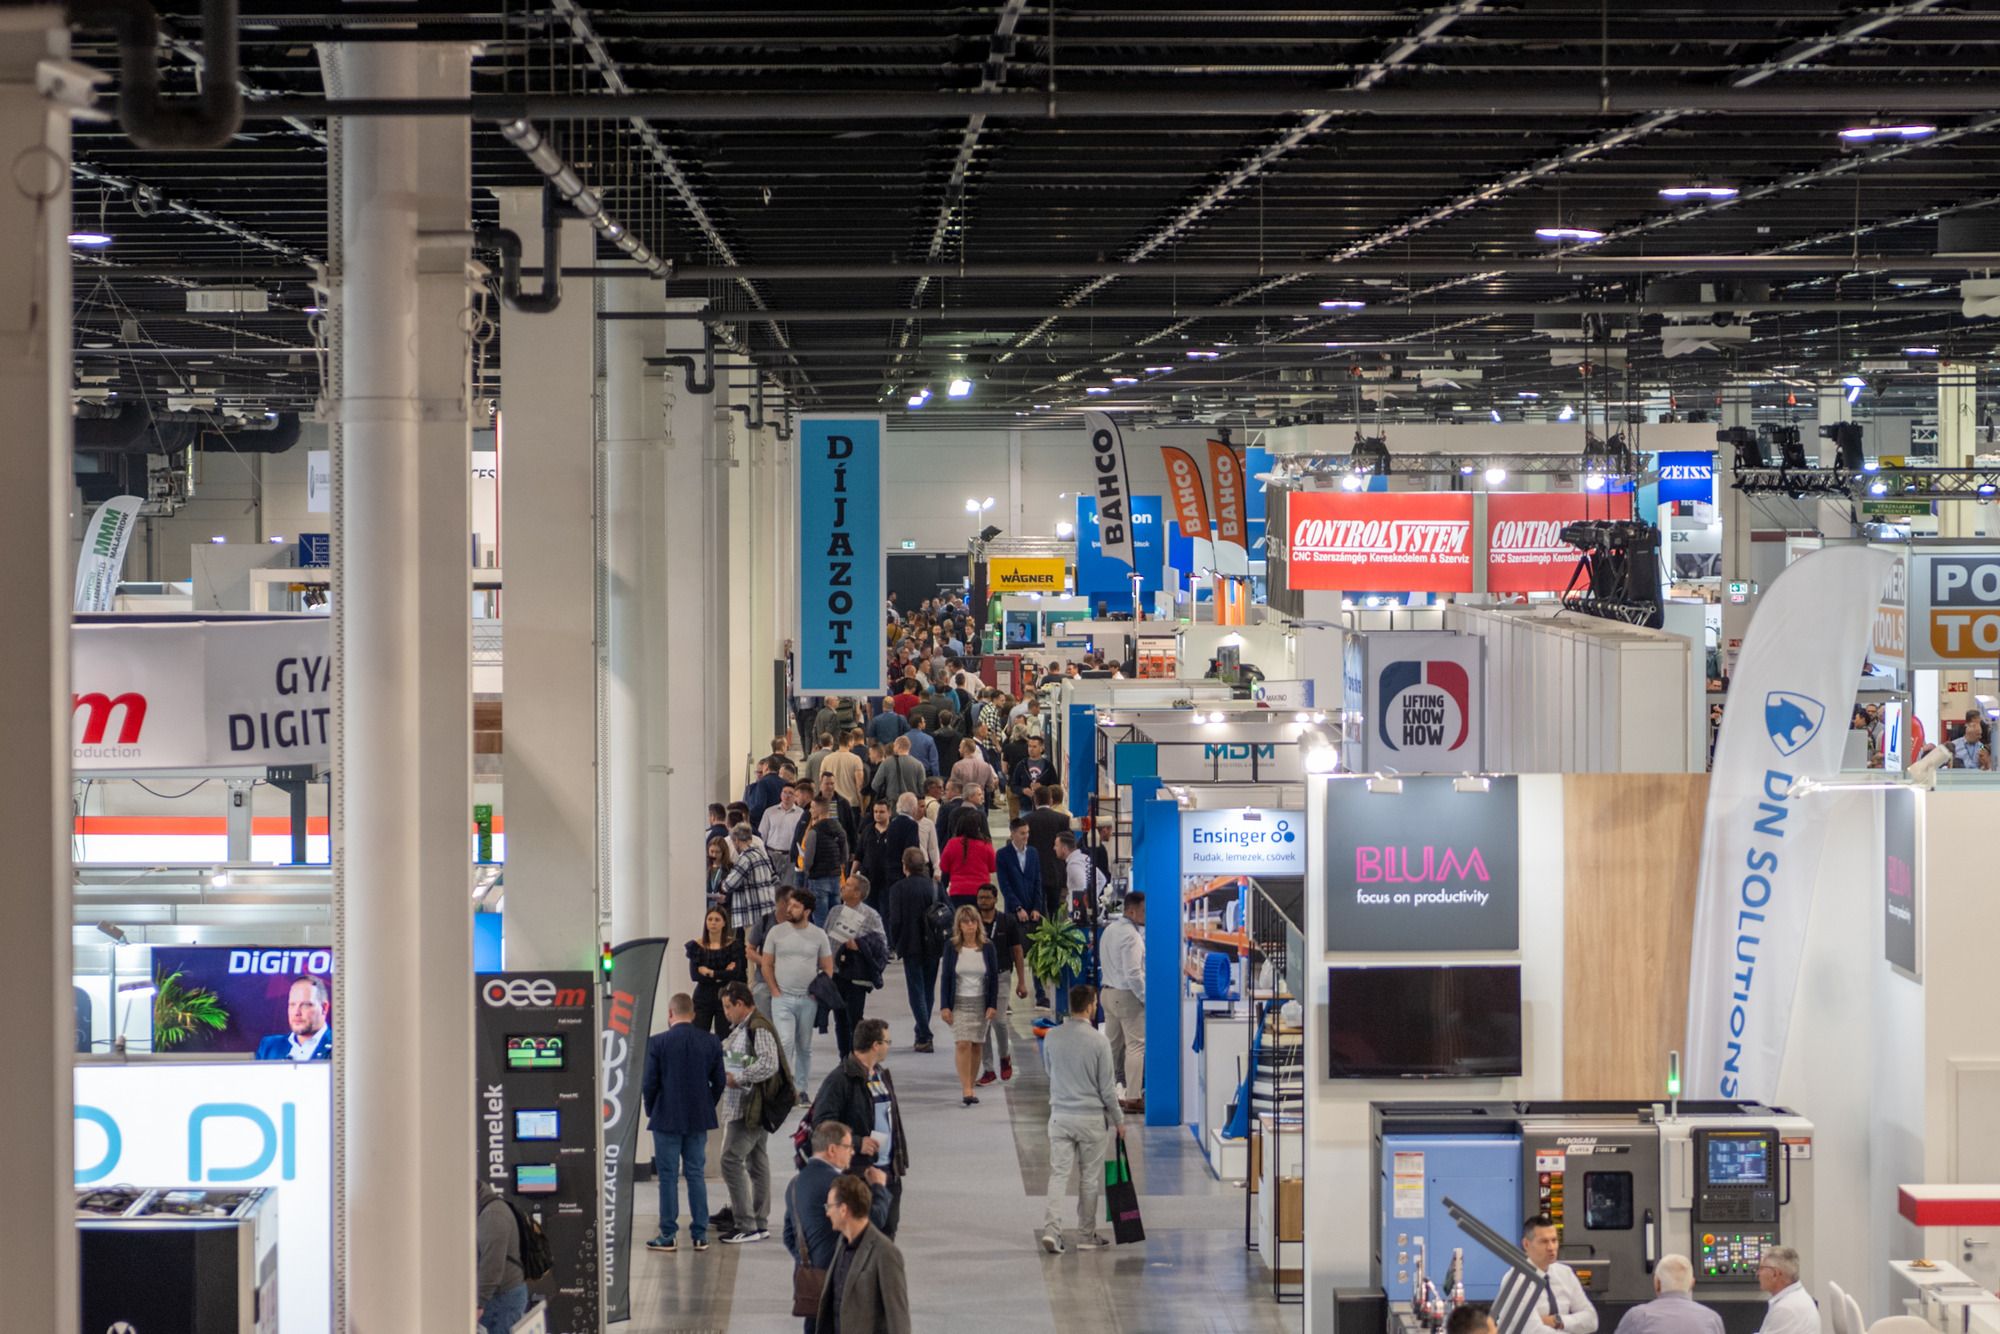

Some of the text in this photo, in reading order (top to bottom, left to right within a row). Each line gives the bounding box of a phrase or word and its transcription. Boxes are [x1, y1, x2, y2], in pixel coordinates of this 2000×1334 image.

[1661, 466, 1712, 480] ZEISS
[1092, 428, 1124, 545] BAHCO
[1173, 459, 1201, 533] BAHCO
[1217, 455, 1239, 536] BAHCO
[93, 507, 121, 557] MMM
[110, 512, 129, 559] MALAGROW
[1293, 519, 1470, 553] CONTROLSYSTEM
[827, 435, 854, 673] DÍJAZOTT
[1292, 551, 1469, 564] CNC Szerszámgép Kereskedelem & Szerviz
[1490, 553, 1506, 563] CNC
[1507, 552, 1551, 565] Szerszámgép
[1001, 569, 1054, 583] WAGNER
[1403, 695, 1444, 708] LIFTING
[1403, 709, 1445, 724] KNOW
[1403, 725, 1445, 746] HOW
[1204, 743, 1275, 760] MDM
[1753, 769, 1793, 837] DN
[1193, 828, 1266, 847] Ensinger
[1193, 852, 1296, 862] Rudak, lemezek, csövek
[1356, 846, 1491, 883] BLUM
[1357, 888, 1489, 906] focus on productivity
[228, 951, 334, 974] DiGiTO
[1720, 847, 1778, 1098] SOLUTIONS
[1556, 1137, 1598, 1145] DOOSAN
